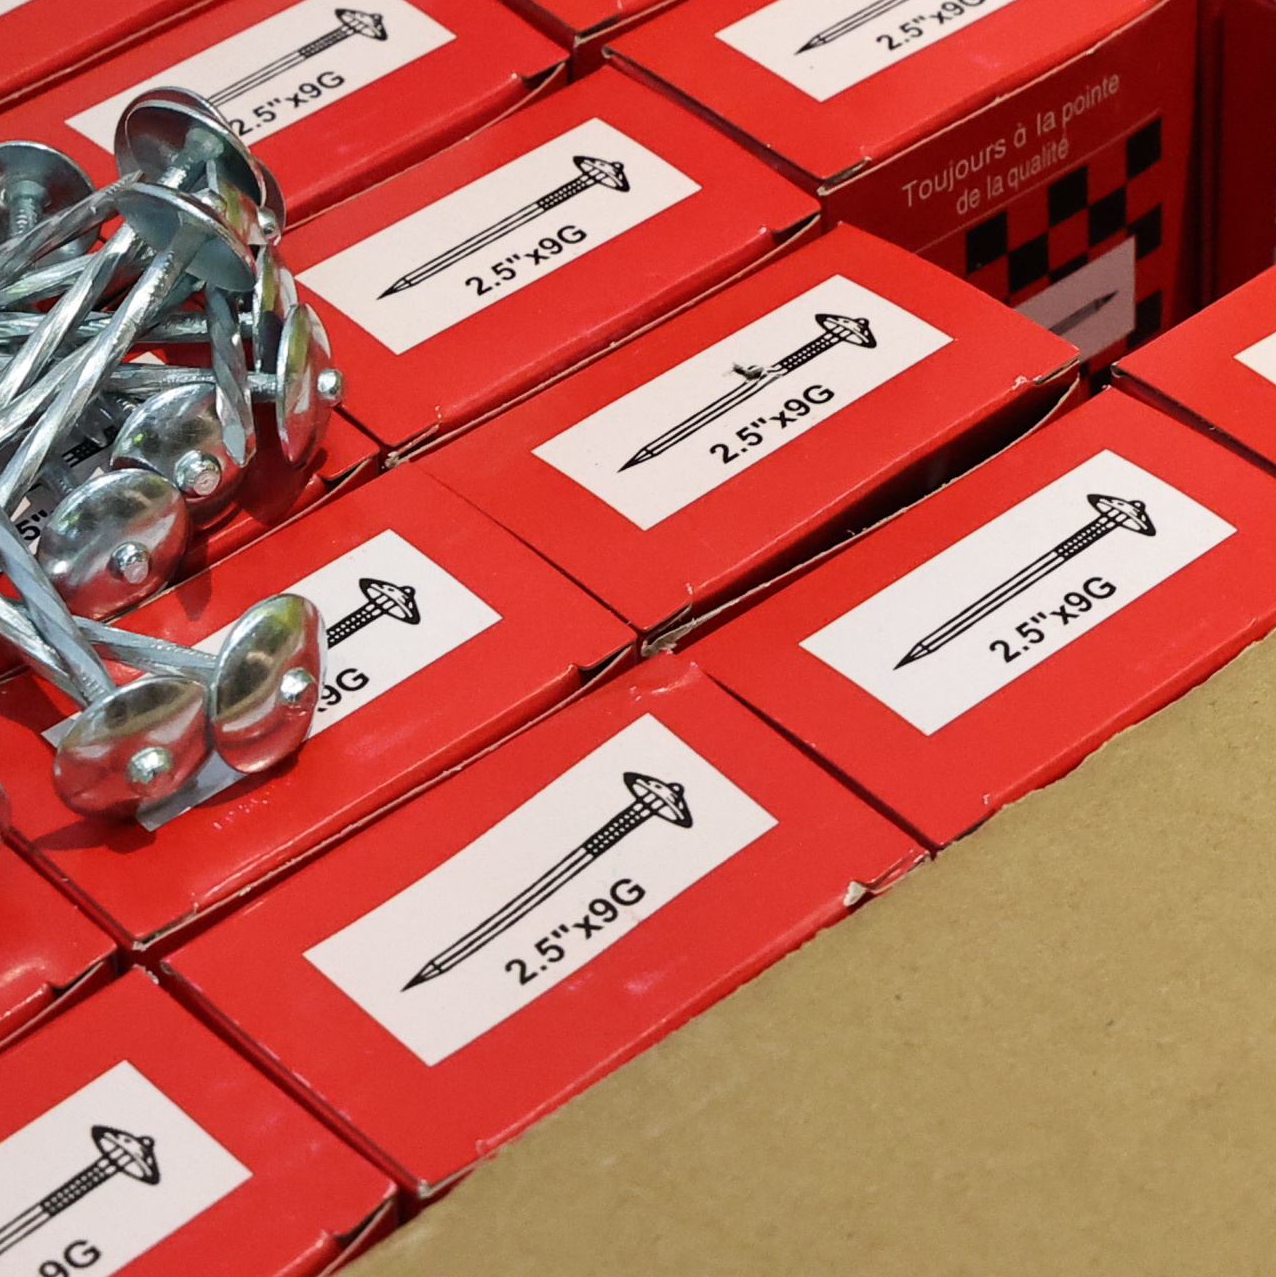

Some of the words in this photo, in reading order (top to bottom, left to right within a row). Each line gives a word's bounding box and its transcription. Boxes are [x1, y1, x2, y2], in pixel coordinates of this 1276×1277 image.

[901, 137, 1007, 208] Toujours
[1036, 111, 1056, 136] la
[1061, 74, 1121, 128] pointe
[956, 187, 982, 215] de
[987, 174, 1004, 199] la
[1007, 131, 1070, 191] qualité
[465, 225, 587, 296] 2.5"x9G
[710, 385, 834, 464] 2.5"x9G
[989, 577, 1116, 663] 2.5"x9G
[505, 879, 646, 985] 2.5"x9G
